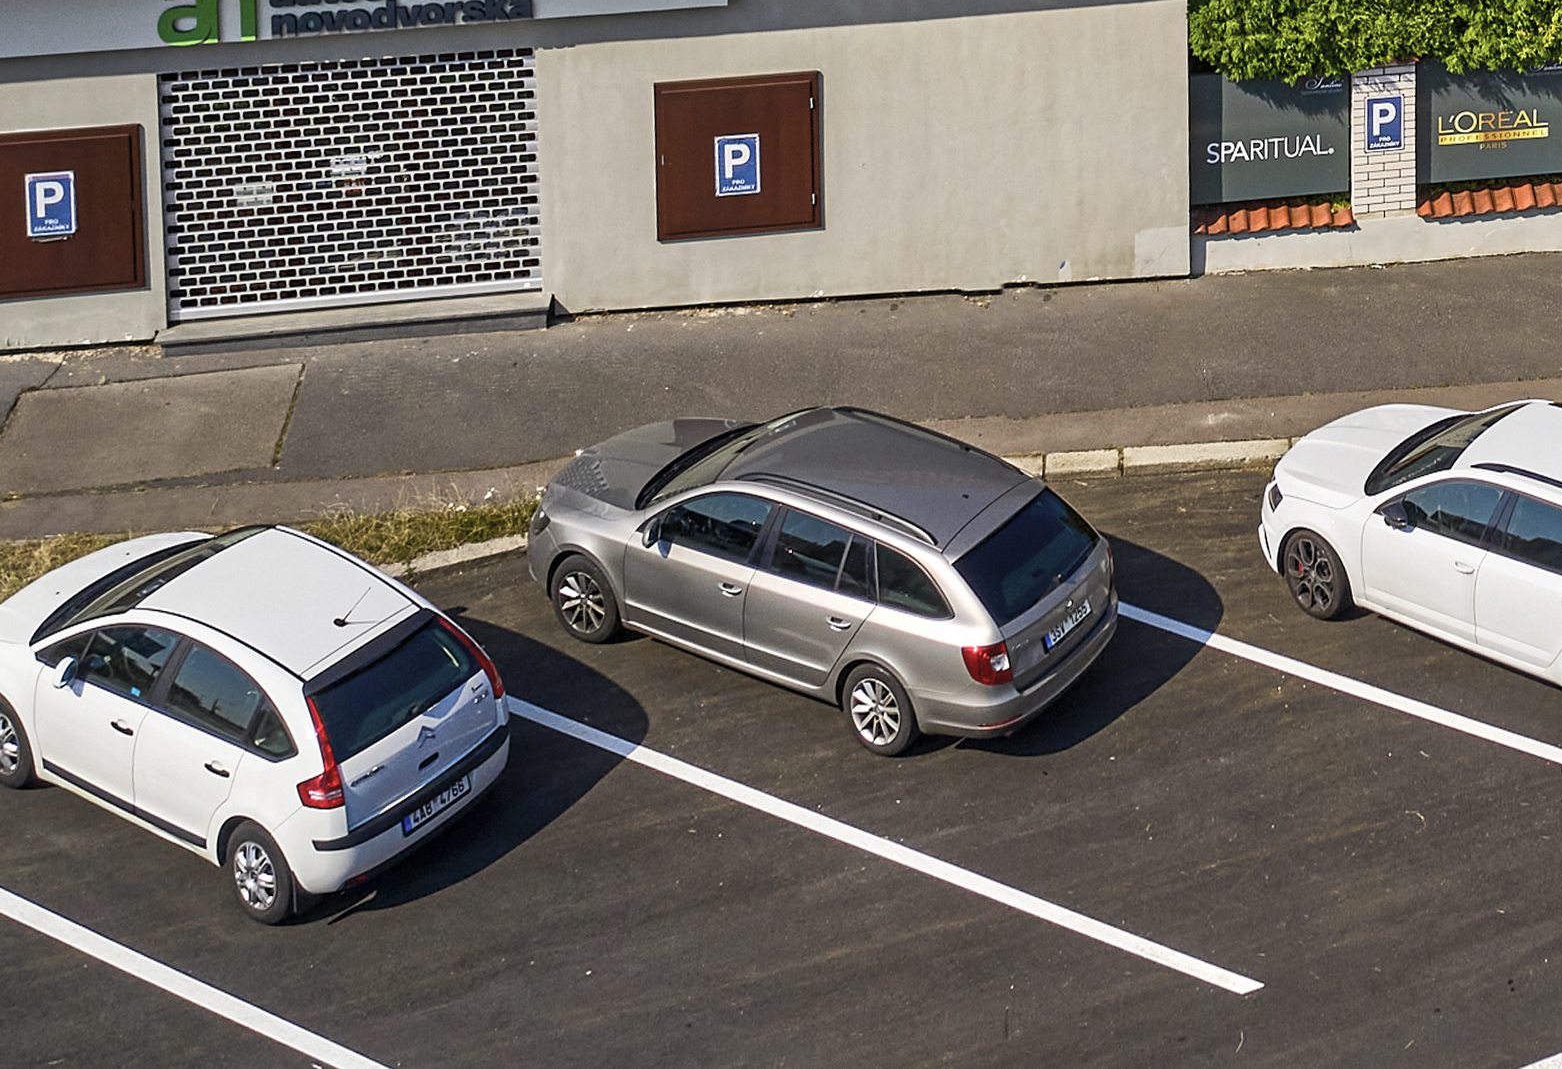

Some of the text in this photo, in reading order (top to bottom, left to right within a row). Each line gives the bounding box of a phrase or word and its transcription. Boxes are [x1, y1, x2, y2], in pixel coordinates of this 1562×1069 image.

[1372, 102, 1396, 136] P
[1440, 129, 1547, 144] PROFESSIONNEL
[1480, 142, 1507, 150] PARIS
[724, 143, 751, 179] P
[36, 181, 65, 218] P
[413, 800, 433, 824] 4AB
